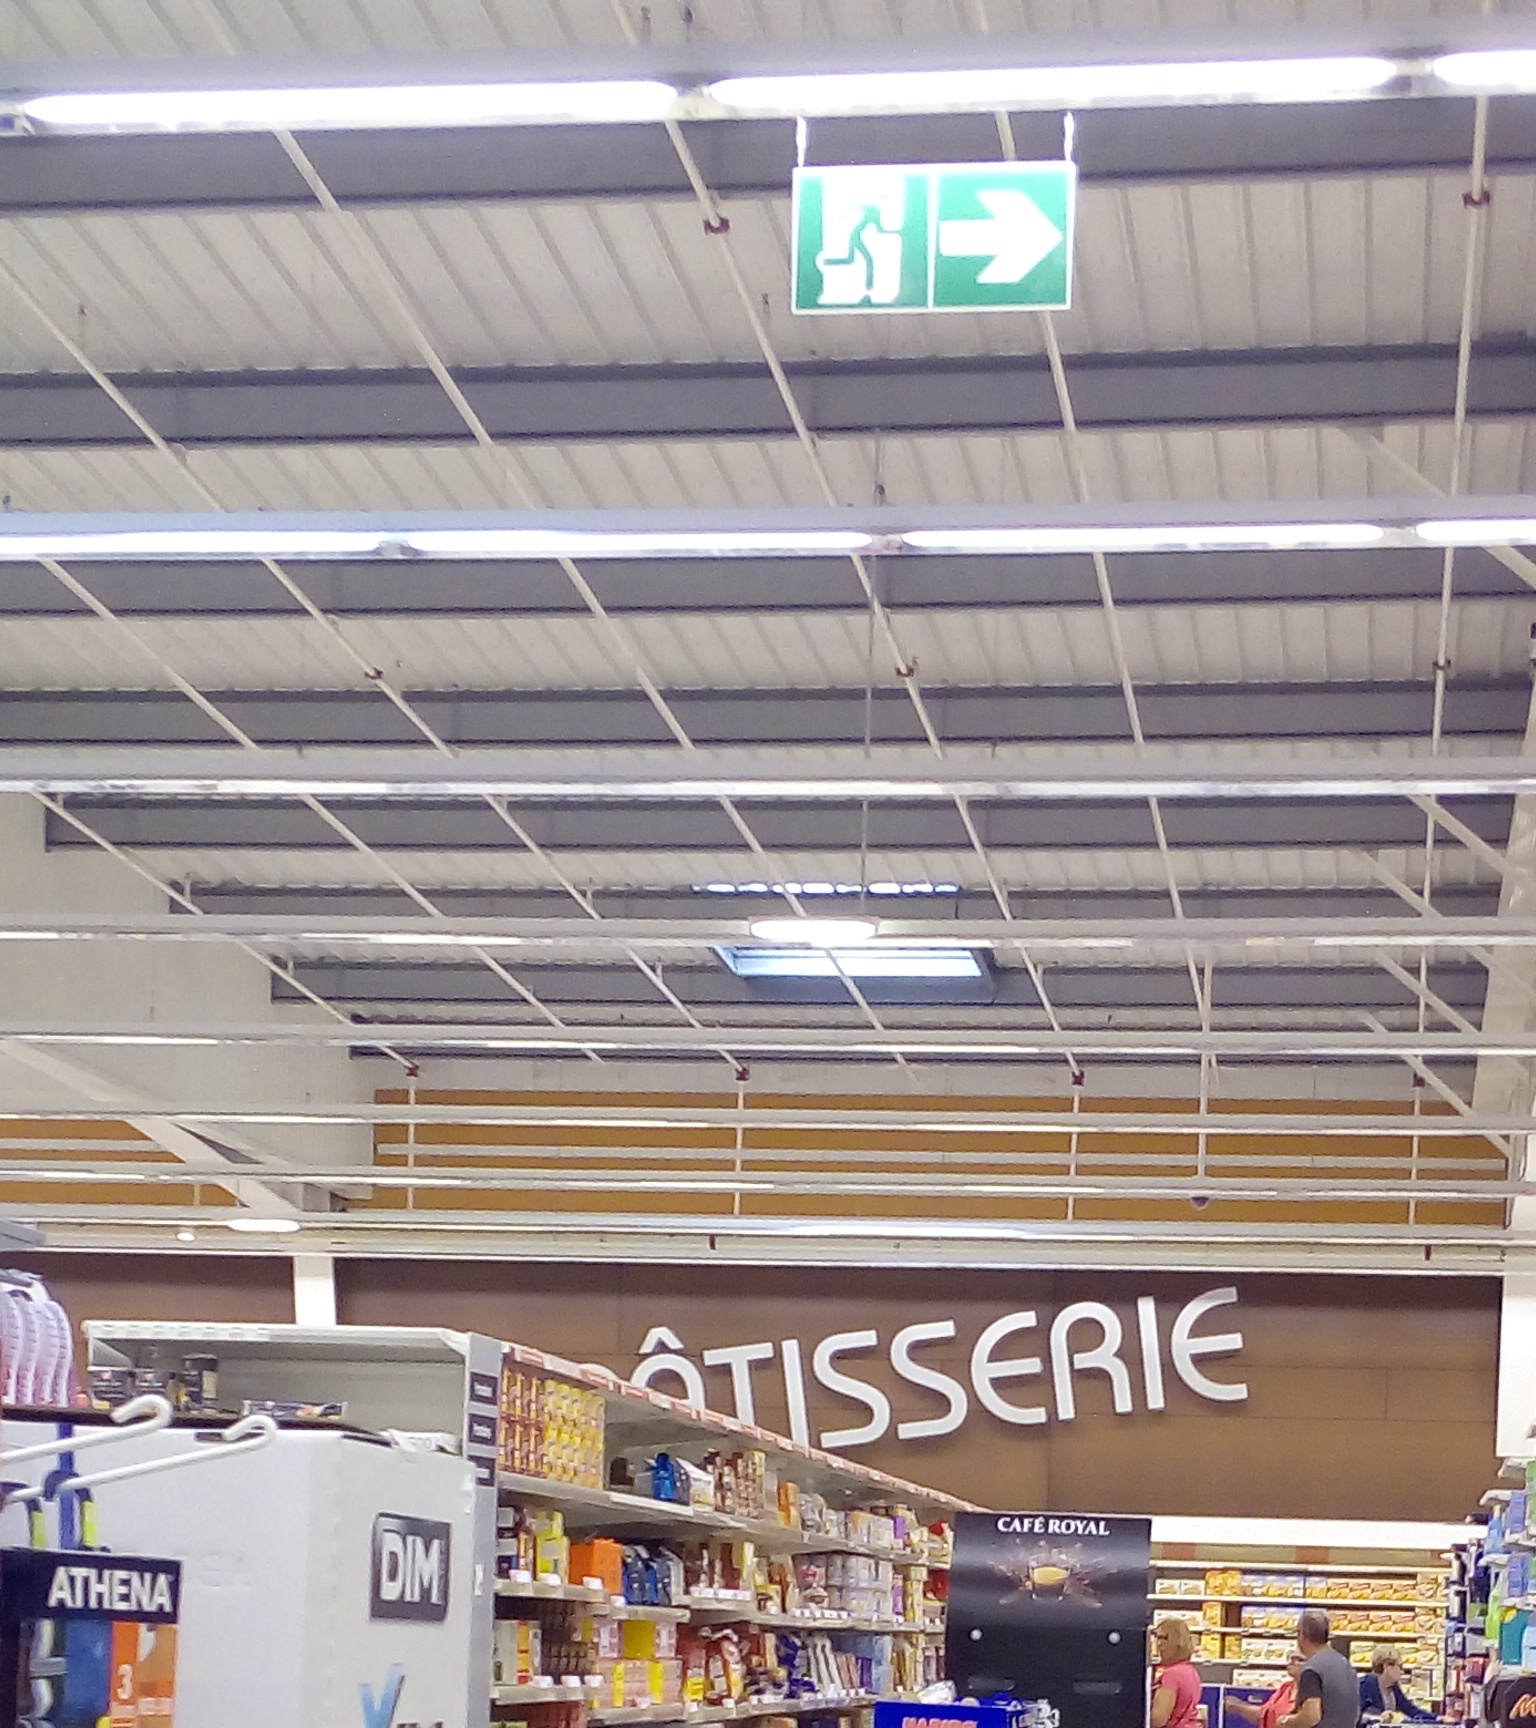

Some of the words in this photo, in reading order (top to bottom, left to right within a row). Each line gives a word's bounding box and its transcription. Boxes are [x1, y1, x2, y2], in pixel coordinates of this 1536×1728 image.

[577, 1286, 1249, 1448] ÂTISSERIE
[997, 1516, 1044, 1533] CAFÉ
[1047, 1518, 1110, 1535] ROYAL
[48, 1566, 174, 1614] ATHENA
[381, 1531, 444, 1605] DIM
[117, 1665, 133, 1699] 3
